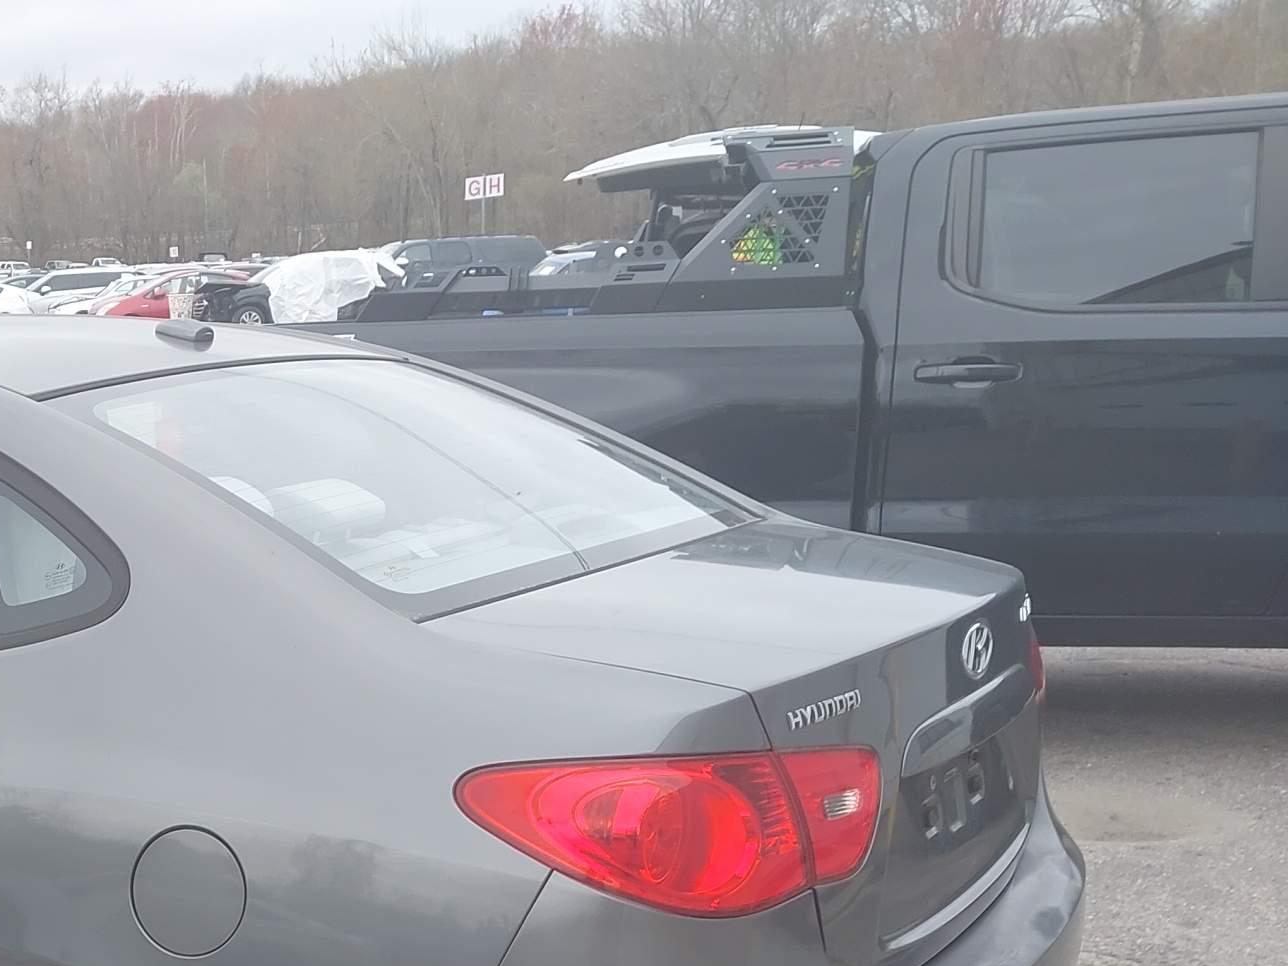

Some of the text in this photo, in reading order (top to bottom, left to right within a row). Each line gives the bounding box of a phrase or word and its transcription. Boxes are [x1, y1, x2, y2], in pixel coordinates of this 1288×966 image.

[469, 176, 500, 196] G H
[787, 689, 861, 730] HYUNDAI
